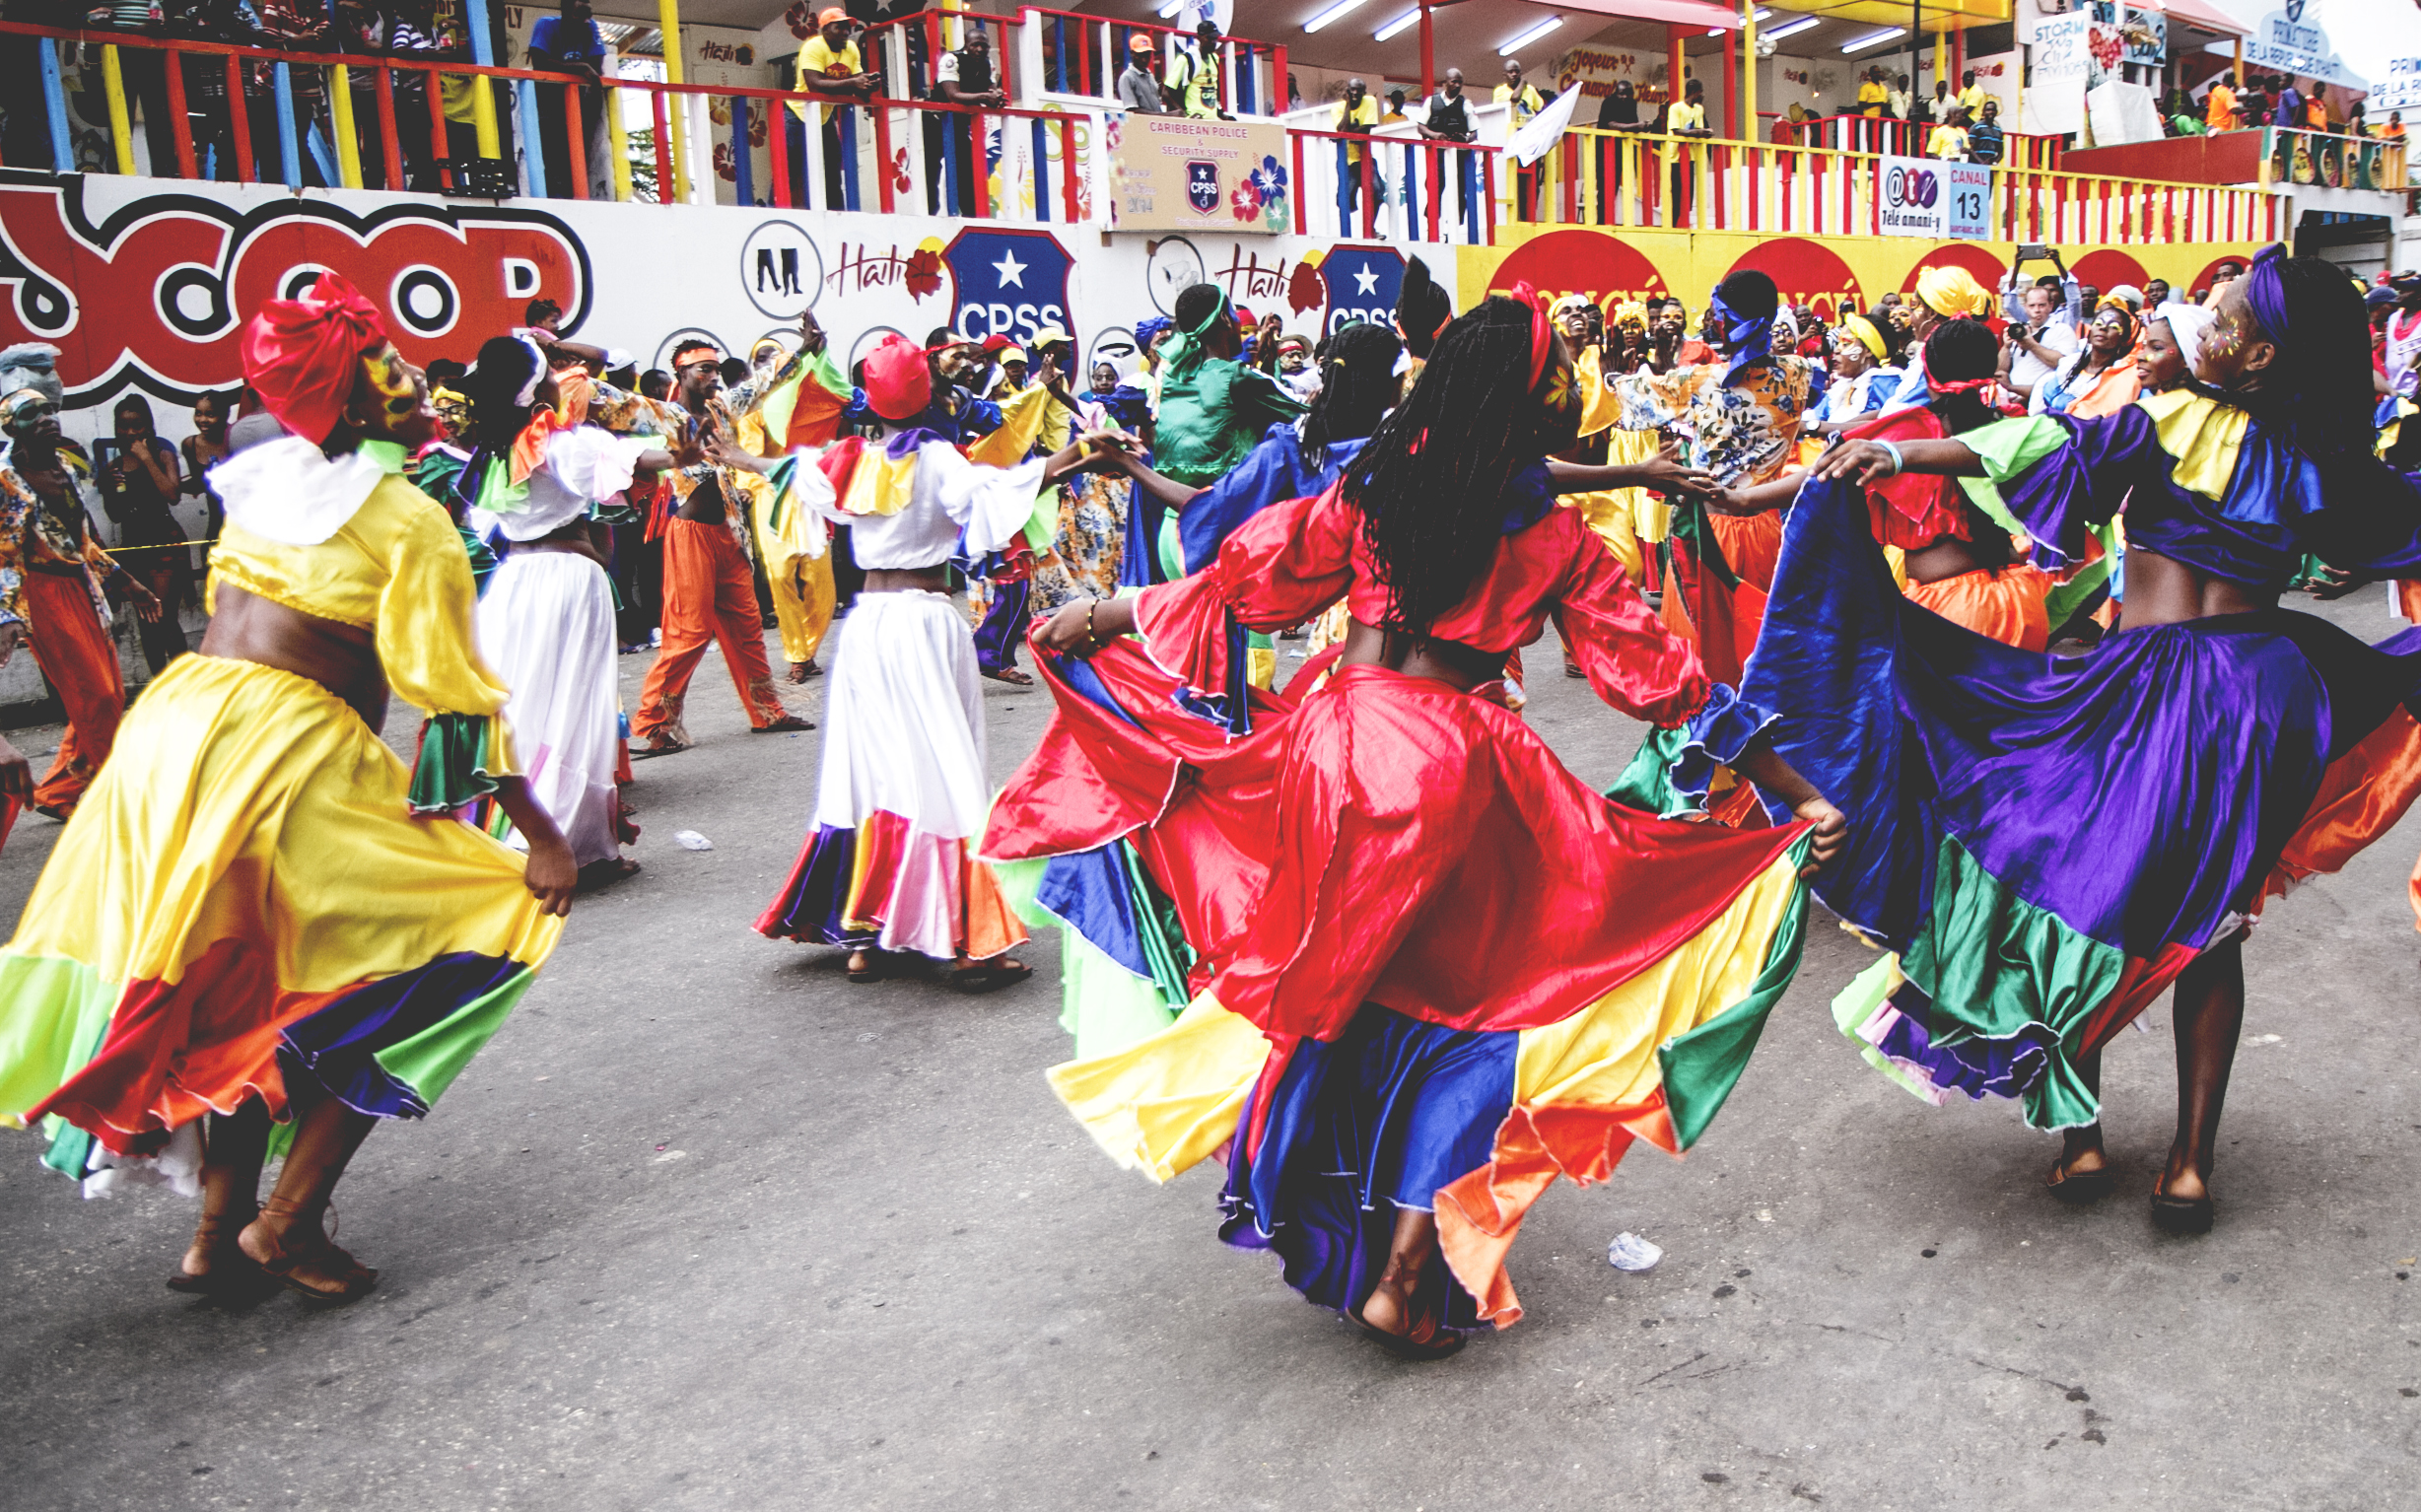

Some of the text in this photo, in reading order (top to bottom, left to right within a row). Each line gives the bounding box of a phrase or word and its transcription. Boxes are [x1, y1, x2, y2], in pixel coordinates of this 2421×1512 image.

[2035, 20, 2084, 42] STORM
[2373, 83, 2387, 97] DE
[2391, 81, 2407, 95] LA
[1149, 121, 1248, 139] CARIBBEAN POLICE
[1197, 138, 1204, 147] &
[1161, 146, 1239, 159] SECURITY SUPPLY
[1951, 169, 1987, 186] CANAL
[1190, 182, 1217, 194] CPSS
[1957, 191, 1981, 221] 13
[957, 303, 1066, 344] CPSS
